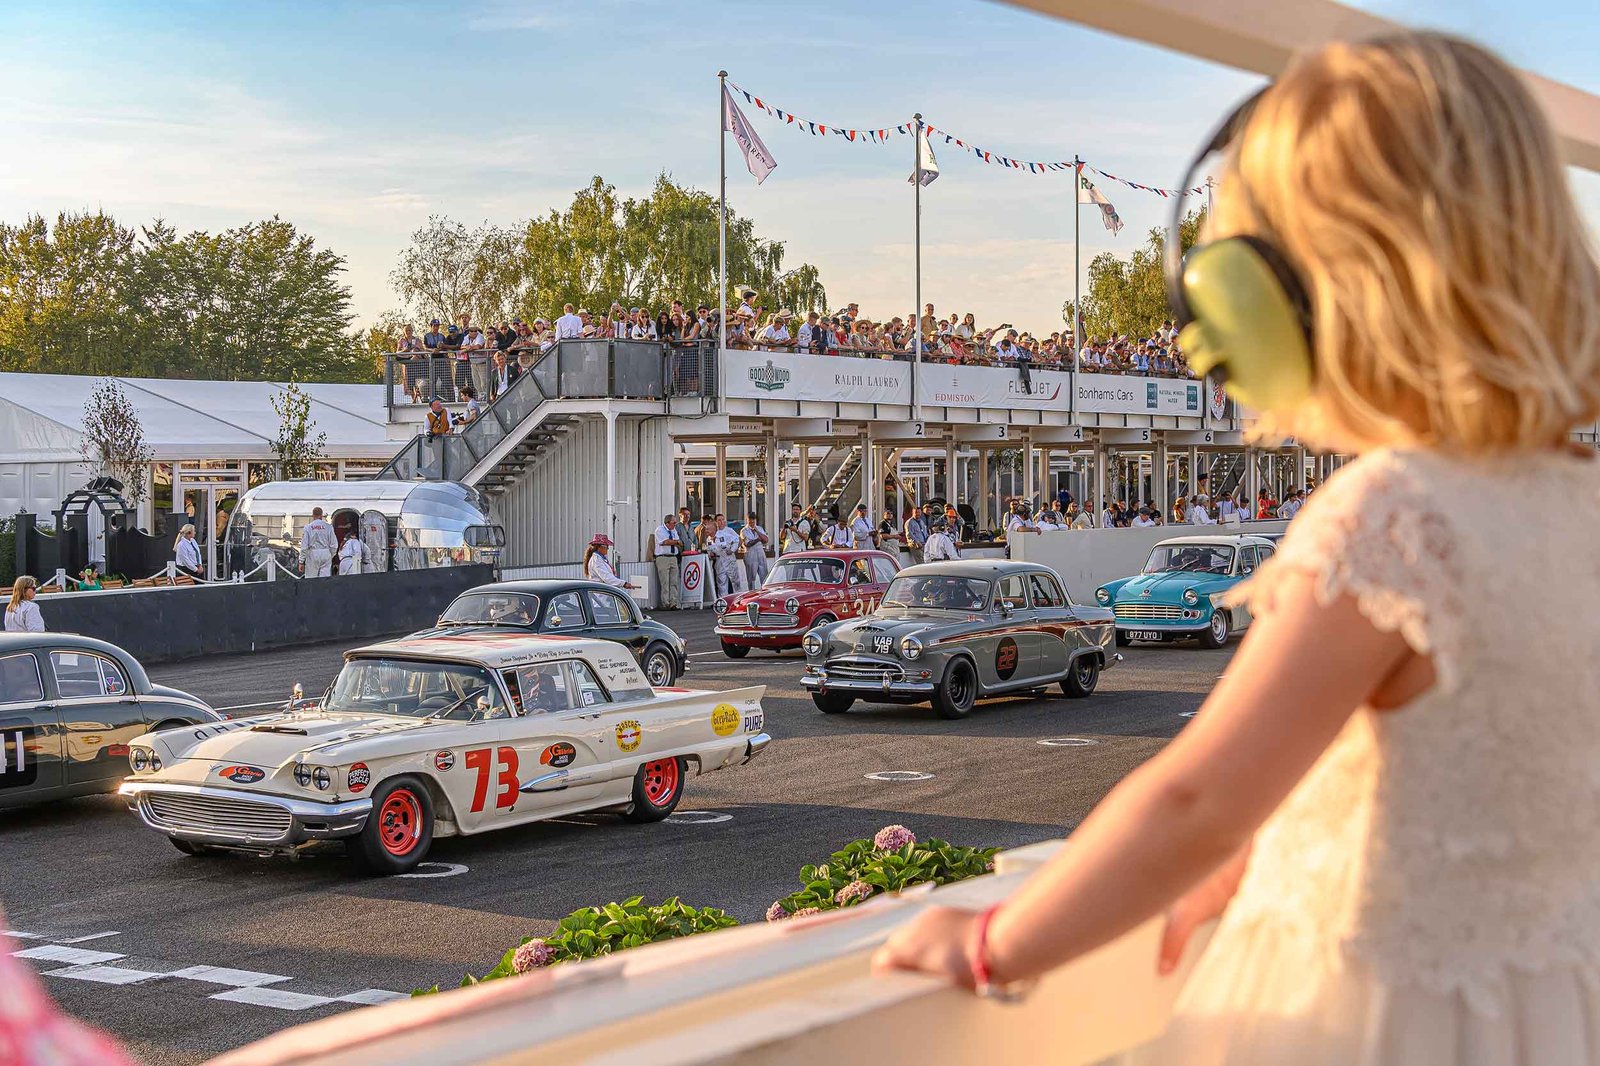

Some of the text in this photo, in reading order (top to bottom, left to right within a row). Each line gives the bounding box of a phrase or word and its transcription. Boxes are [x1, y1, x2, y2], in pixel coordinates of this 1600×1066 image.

[835, 374, 899, 388] RALPH LAUREN
[935, 393, 975, 403] EDMISTON
[1078, 387, 1134, 401] Bonhams Cars
[826, 420, 830, 433] 1
[915, 424, 922, 435] 2
[998, 426, 1005, 438] 3
[1073, 428, 1081, 439] 4
[1142, 430, 1149, 441] 5
[1205, 432, 1212, 442] 6
[687, 571, 698, 585] 20
[873, 636, 893, 645] VAB
[875, 644, 890, 654] 719
[997, 645, 1017, 670] 22
[743, 714, 762, 732] PURE
[349, 769, 369, 779] PERFECT
[465, 746, 520, 813] 73
[350, 776, 369, 785] CIRCLE
